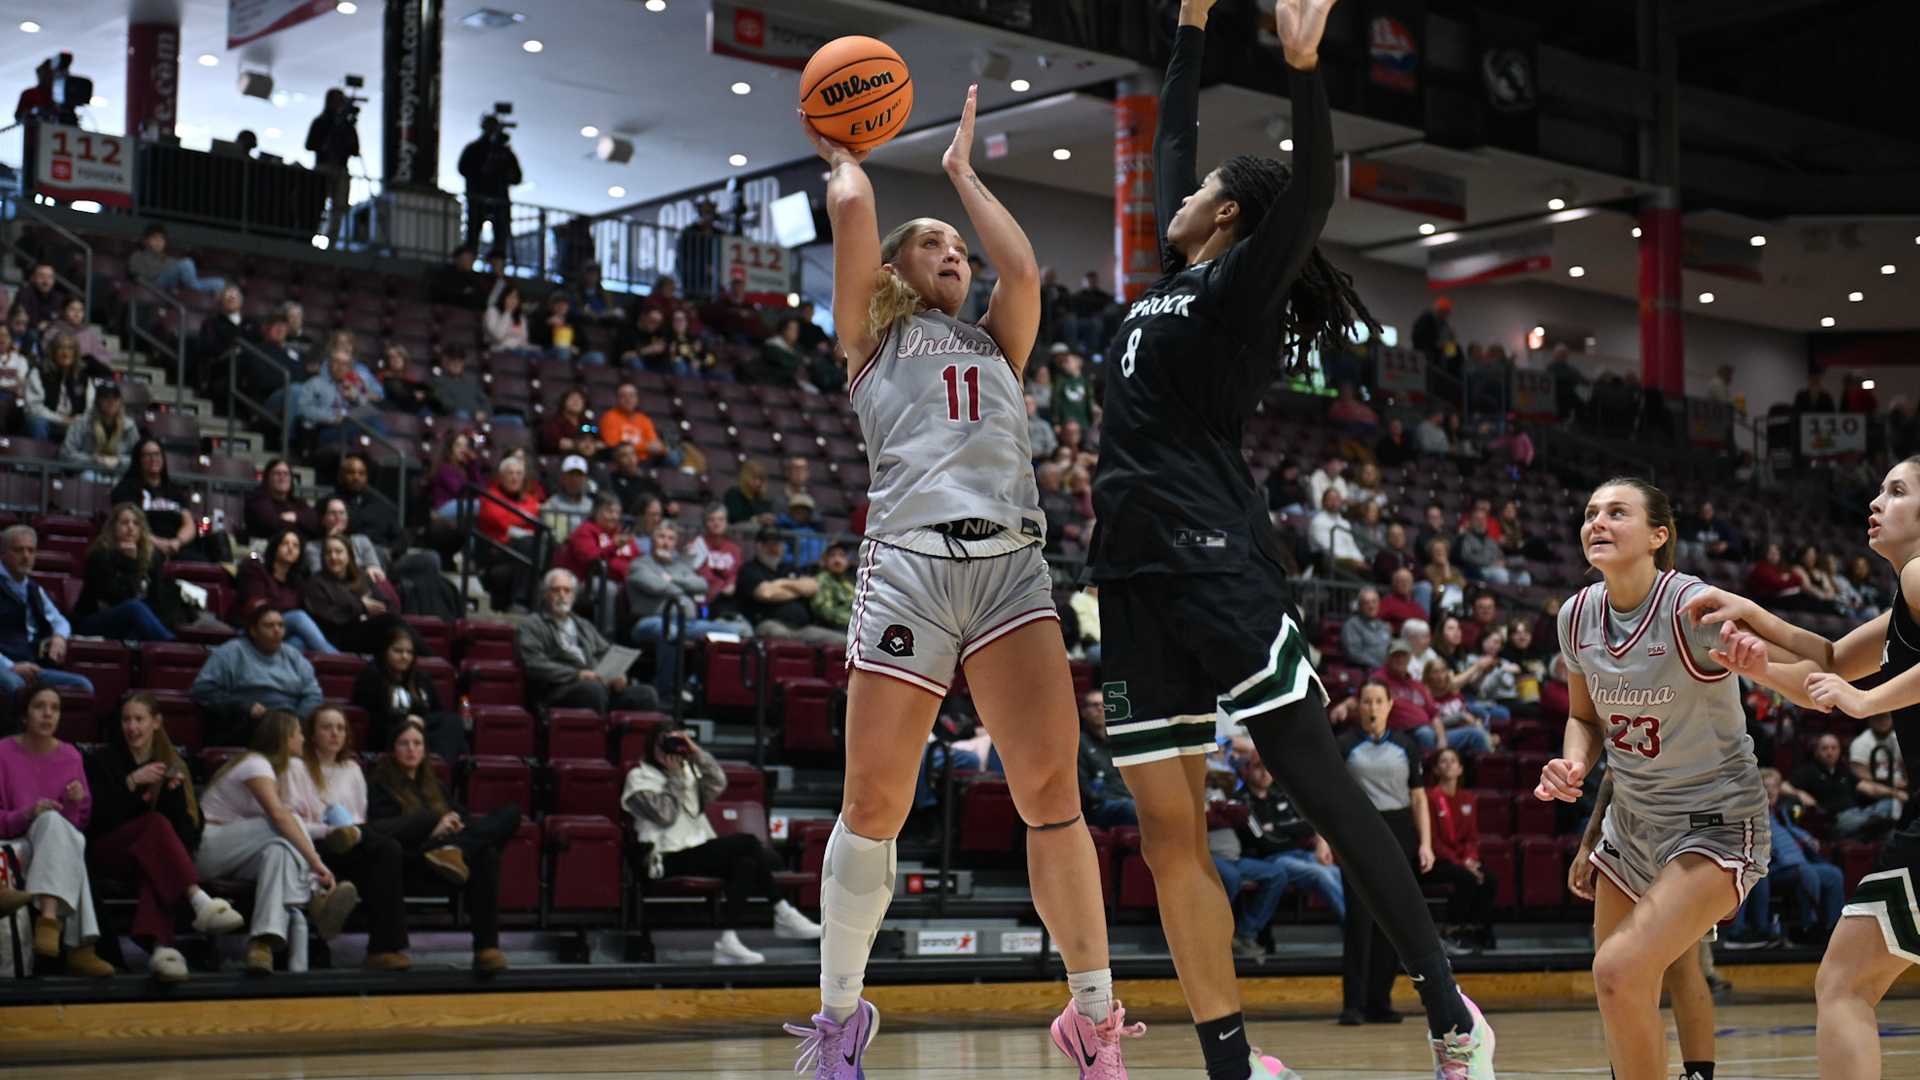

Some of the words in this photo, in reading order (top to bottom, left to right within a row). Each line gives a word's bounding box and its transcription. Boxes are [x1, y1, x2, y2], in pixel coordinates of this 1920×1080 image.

[820, 71, 895, 106] Wilson
[51, 132, 123, 166] 112
[730, 243, 783, 271] 112
[1120, 327, 1142, 378] 8
[941, 364, 981, 423] 11
[1808, 417, 1859, 436] 110
[961, 519, 1003, 535] NIK
[1647, 645, 1667, 654] PSAC
[1590, 673, 1676, 706] Indiana
[1608, 713, 1662, 760] 23
